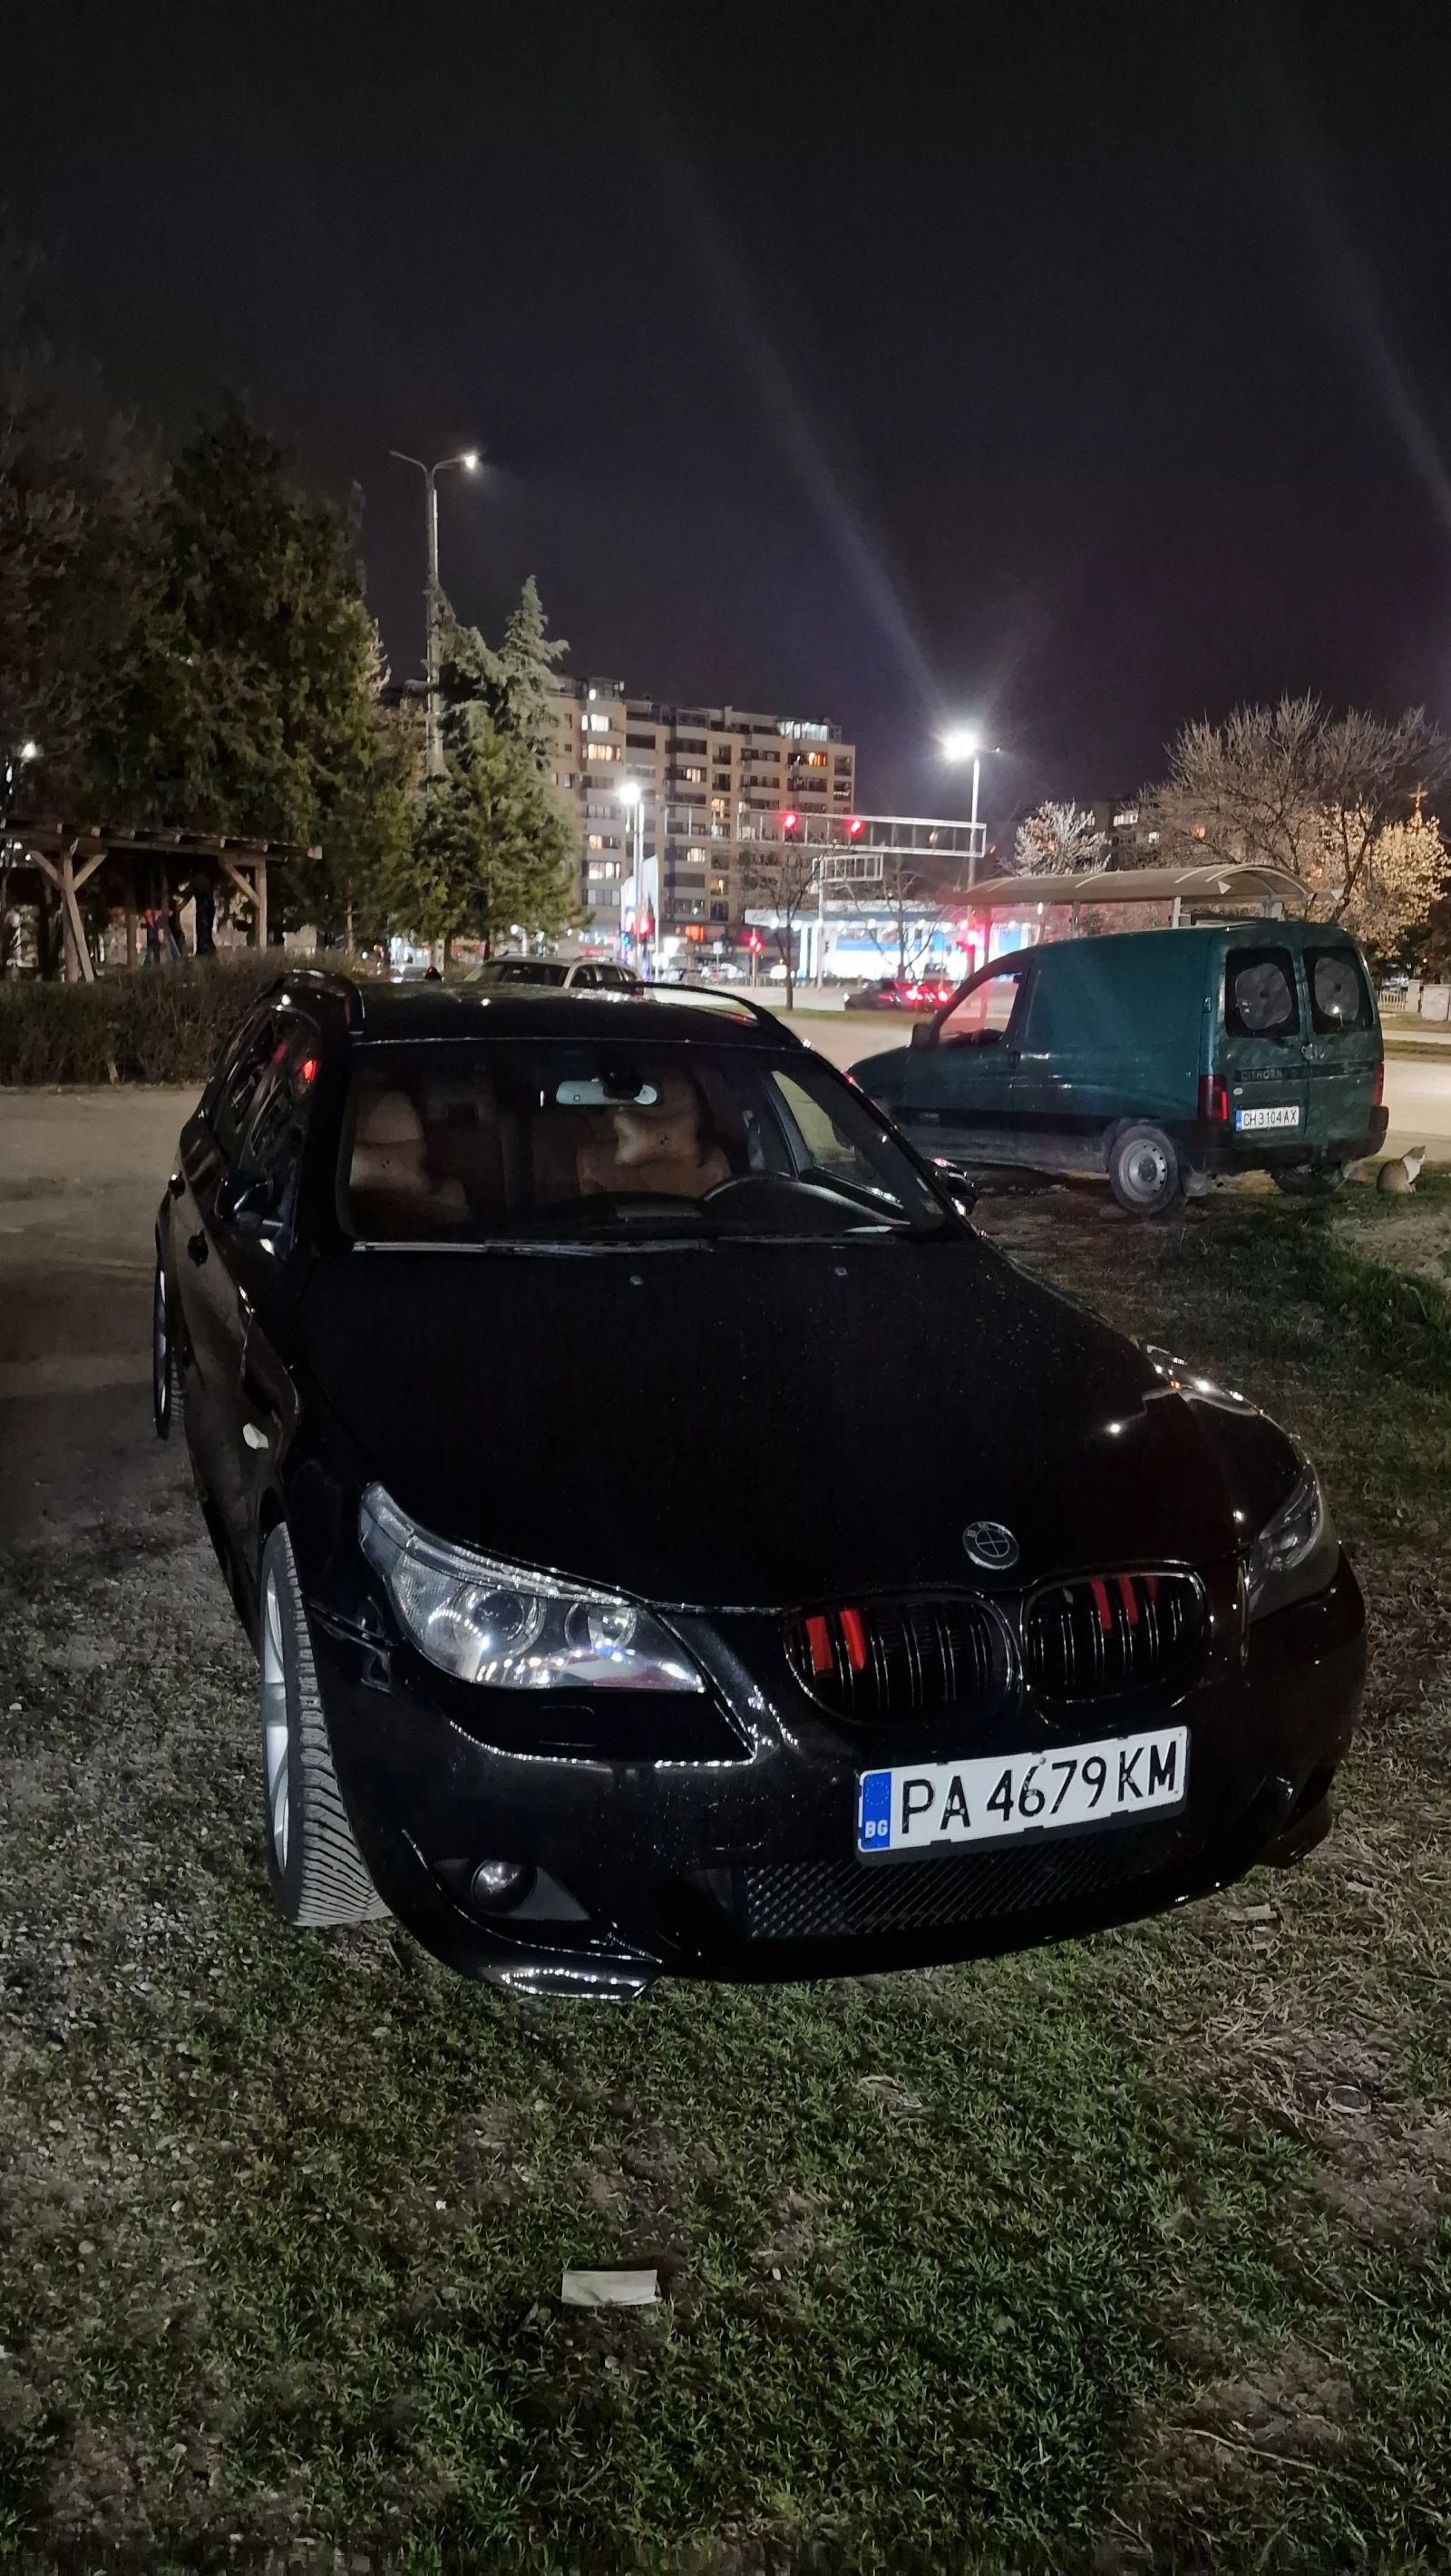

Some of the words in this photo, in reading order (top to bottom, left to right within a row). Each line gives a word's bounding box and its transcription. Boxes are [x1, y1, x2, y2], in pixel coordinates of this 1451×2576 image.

[1258, 1111, 1281, 1125] 3104
[1283, 1109, 1297, 1123] AX
[901, 1774, 971, 1834] PA
[985, 1755, 1107, 1822] 4679
[1116, 1740, 1178, 1803] KM
[864, 1819, 889, 1839] BG
